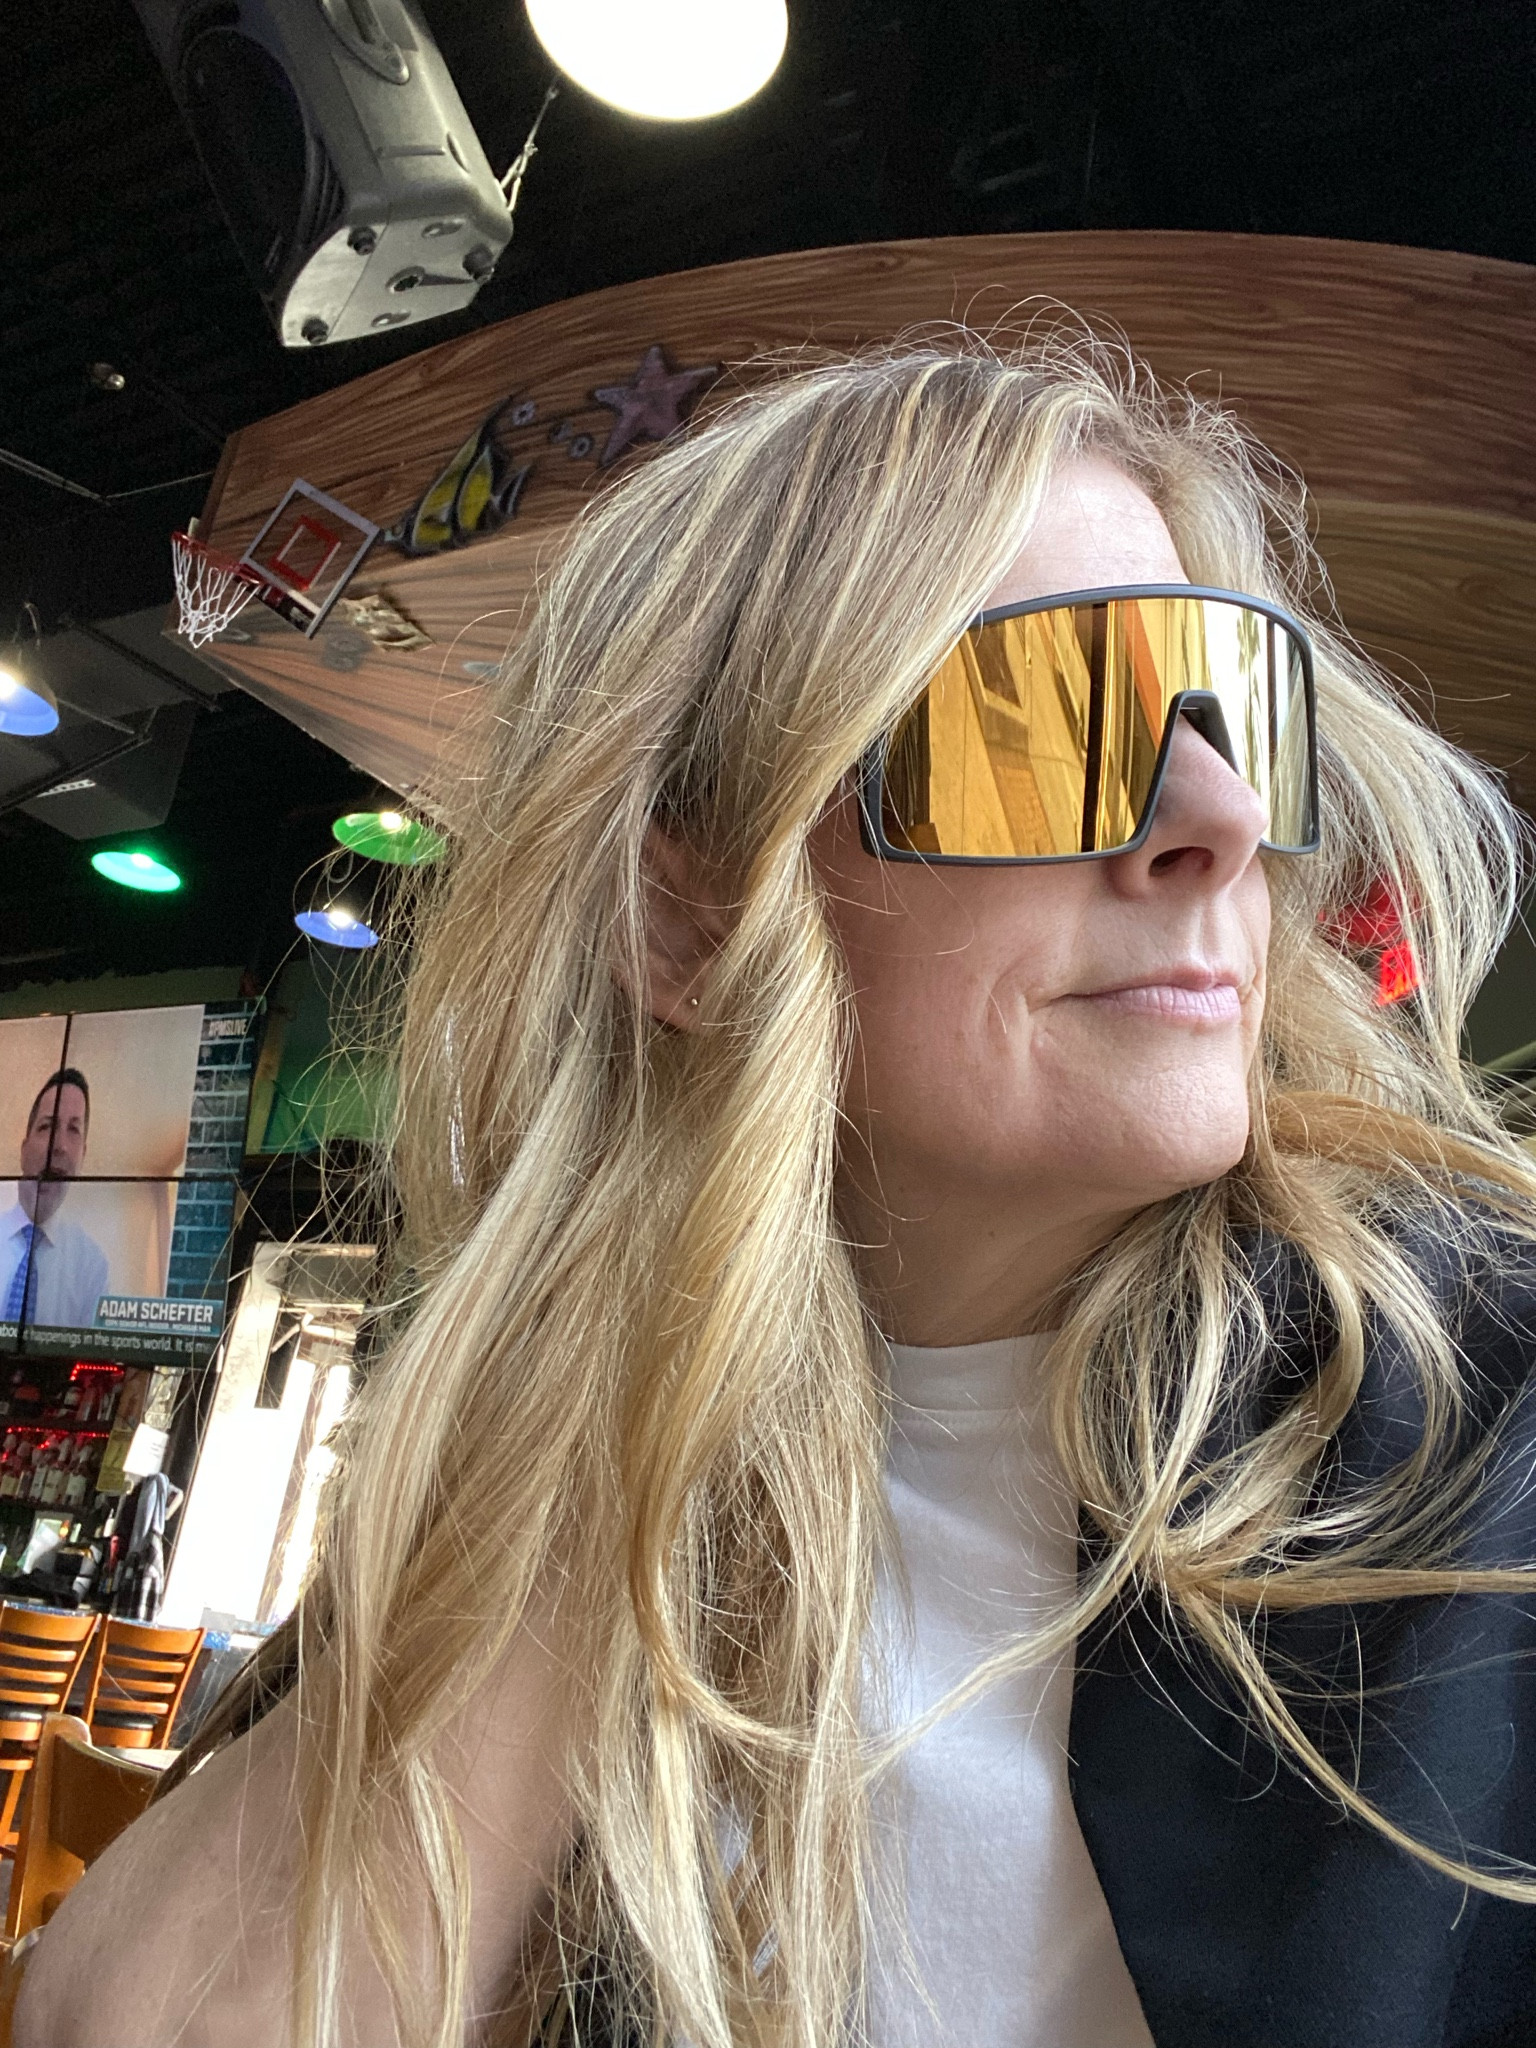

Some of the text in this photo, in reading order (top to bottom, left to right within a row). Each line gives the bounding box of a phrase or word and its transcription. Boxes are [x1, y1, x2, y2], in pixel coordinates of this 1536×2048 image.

[99, 1299, 214, 1323] ADAM SCHEFTER
[30, 1325, 82, 1348] happenings
[94, 1333, 110, 1347] the
[111, 1336, 142, 1351] sports
